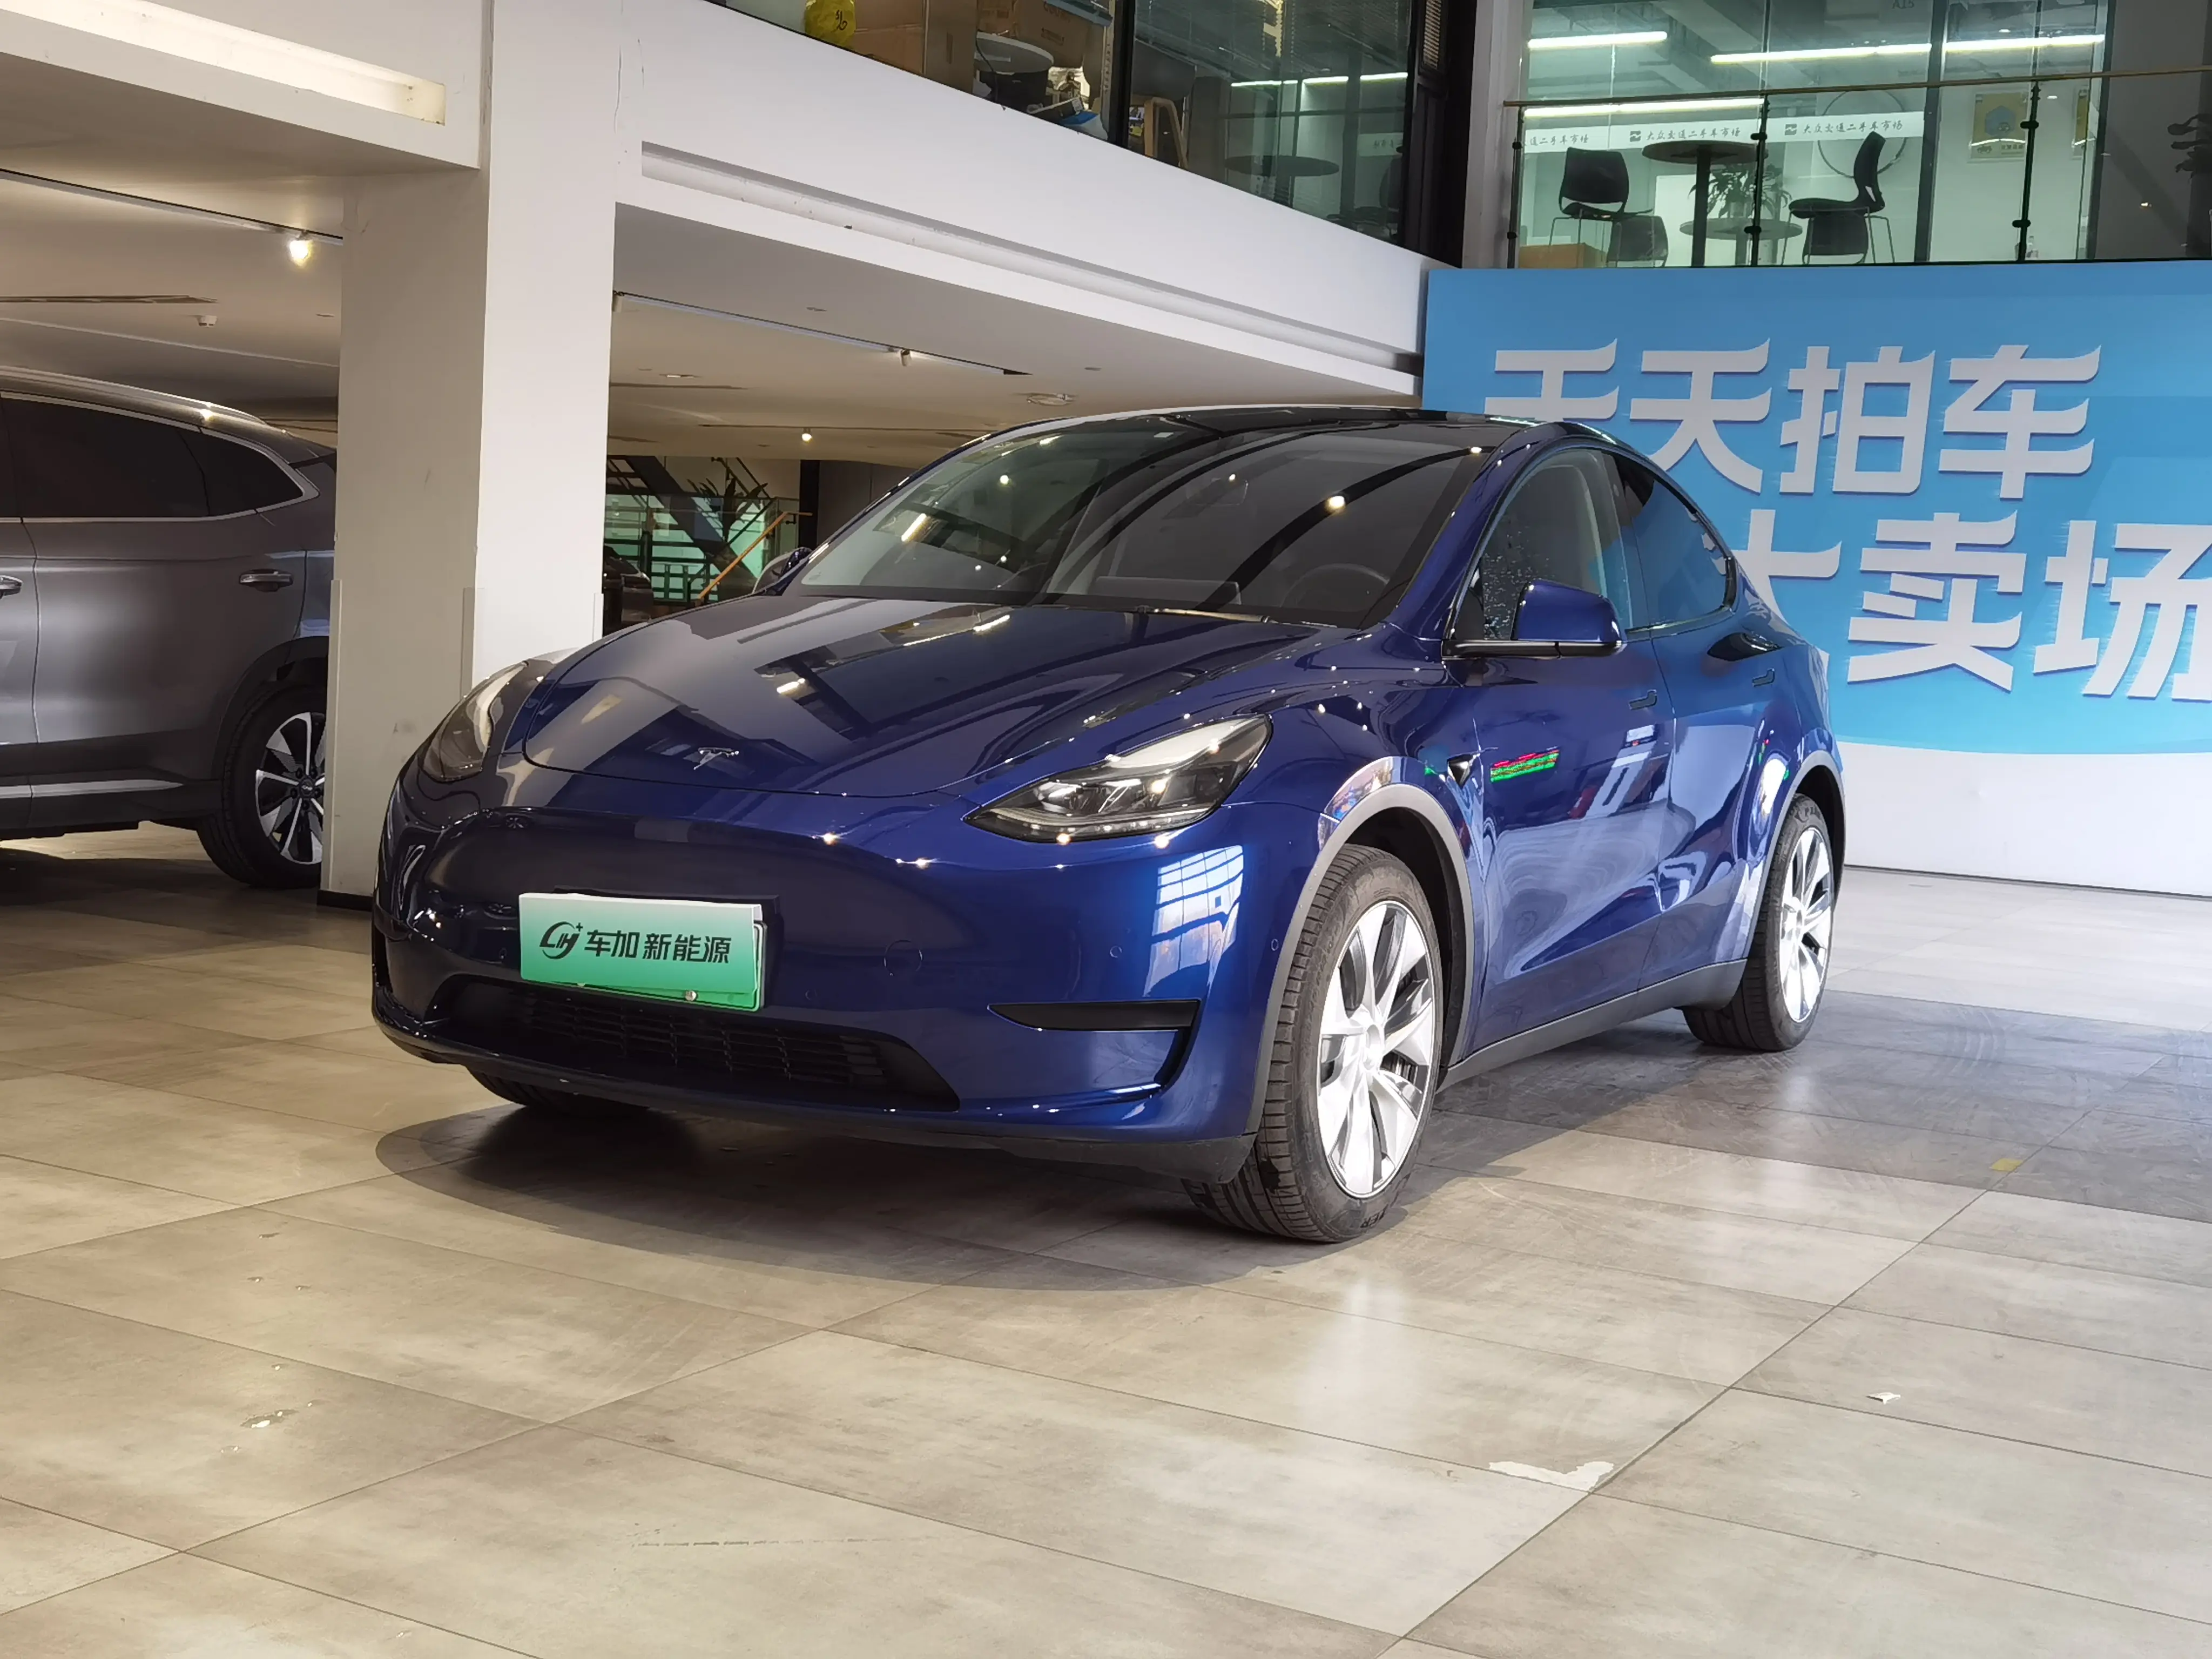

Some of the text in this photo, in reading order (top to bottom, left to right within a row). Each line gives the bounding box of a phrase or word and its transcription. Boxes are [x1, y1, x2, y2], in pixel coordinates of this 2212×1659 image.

[1525, 134, 1589, 146] 通二手车市场
[1483, 337, 2101, 500] 天天拍车
